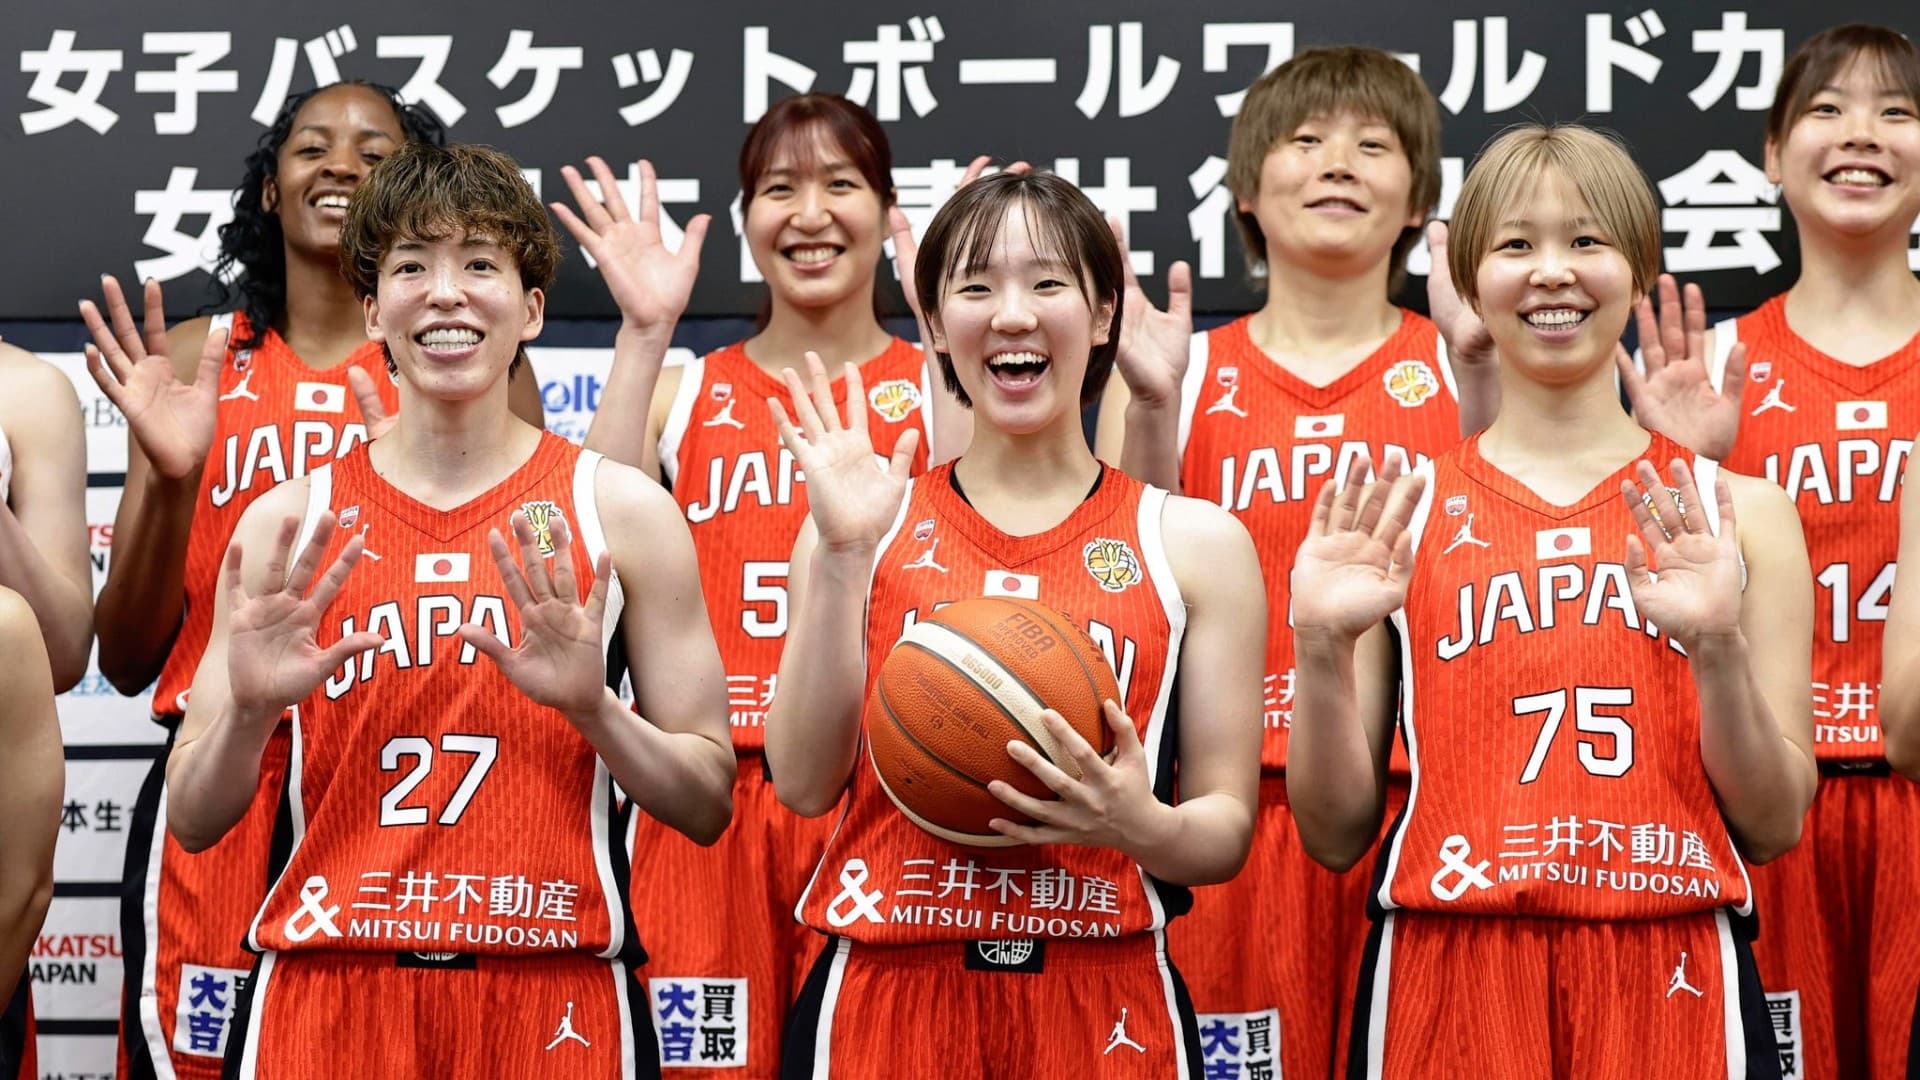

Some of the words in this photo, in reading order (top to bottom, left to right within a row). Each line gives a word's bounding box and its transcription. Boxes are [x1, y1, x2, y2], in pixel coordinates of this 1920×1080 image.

[20, 9, 1785, 135] 女子バスケットボールワルドカ
[1436, 561, 1689, 662] JAPA
[1816, 561, 1898, 643] 14
[1006, 612, 1057, 652] FIBA
[1811, 681, 1882, 720] 三井
[1512, 685, 1635, 785] 75
[379, 733, 500, 827] 27
[62, 799, 134, 833] 本生
[1498, 815, 1716, 872] 三井不動産
[351, 869, 580, 923] 三井不動産
[895, 857, 1122, 915] 三井不動産
[1498, 861, 1588, 887] MITSUI
[1595, 868, 1721, 900] FUDOSAN
[347, 918, 441, 941] MITSUI
[449, 921, 579, 950] FUDOSAN
[890, 904, 982, 930] MITSUI
[990, 909, 1122, 939] FUDOSAN
[188, 971, 229, 1052] 大吉
[657, 982, 697, 1062] 大吉
[700, 983, 737, 1062] 買取
